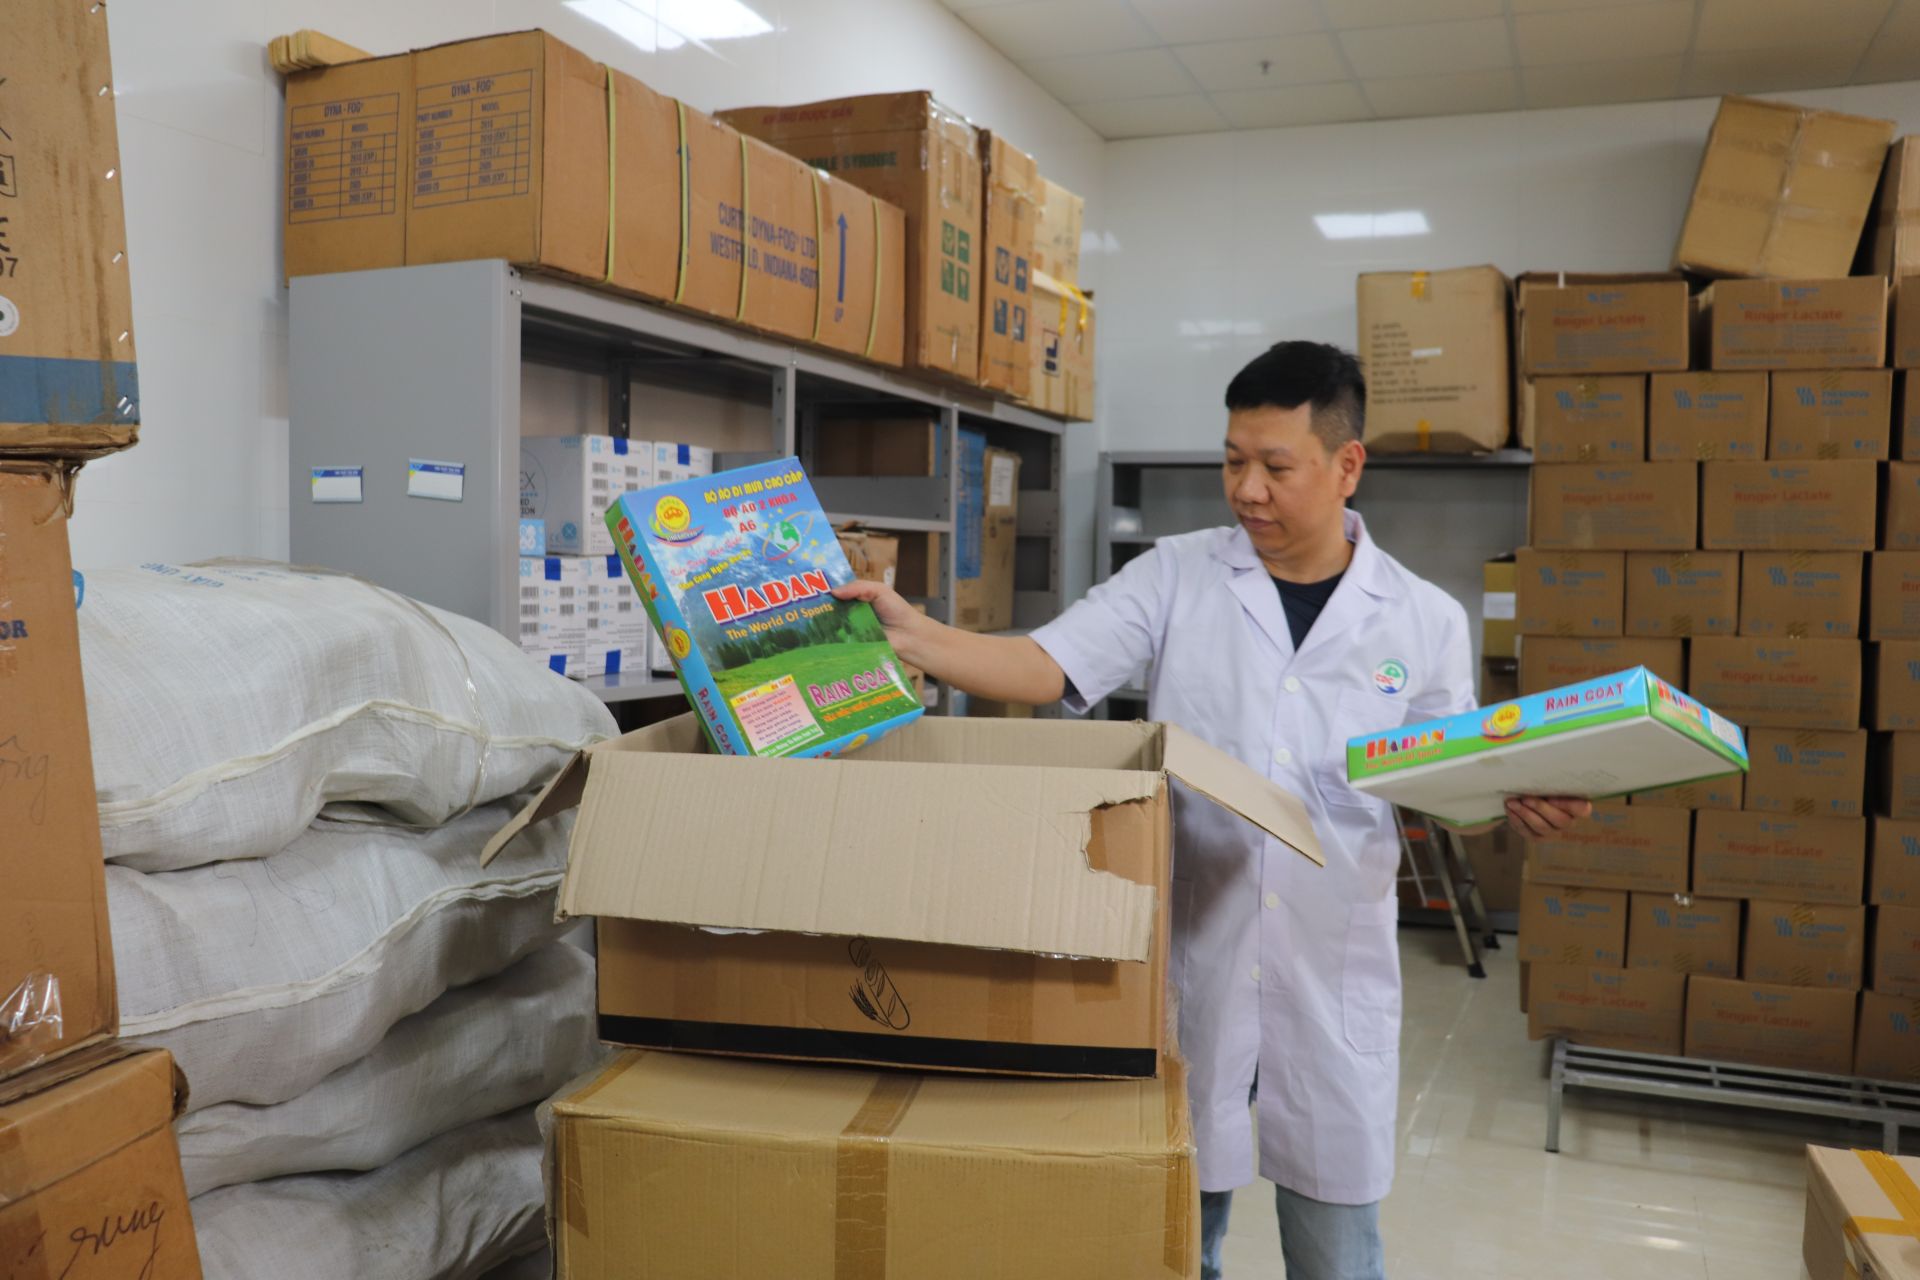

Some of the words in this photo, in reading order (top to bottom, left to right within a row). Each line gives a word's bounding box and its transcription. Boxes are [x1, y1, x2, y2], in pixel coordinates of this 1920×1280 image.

[763, 252, 798, 282] INDIANA
[740, 519, 757, 534] A6
[702, 569, 831, 624] HADAN
[726, 628, 748, 640] The
[749, 614, 785, 634] World
[785, 609, 800, 623] Of
[800, 602, 834, 619] Sports
[698, 687, 718, 721] RAIN
[807, 684, 853, 707] RAIN
[1545, 694, 1579, 711] RAIN
[1365, 727, 1445, 760] HADAN
